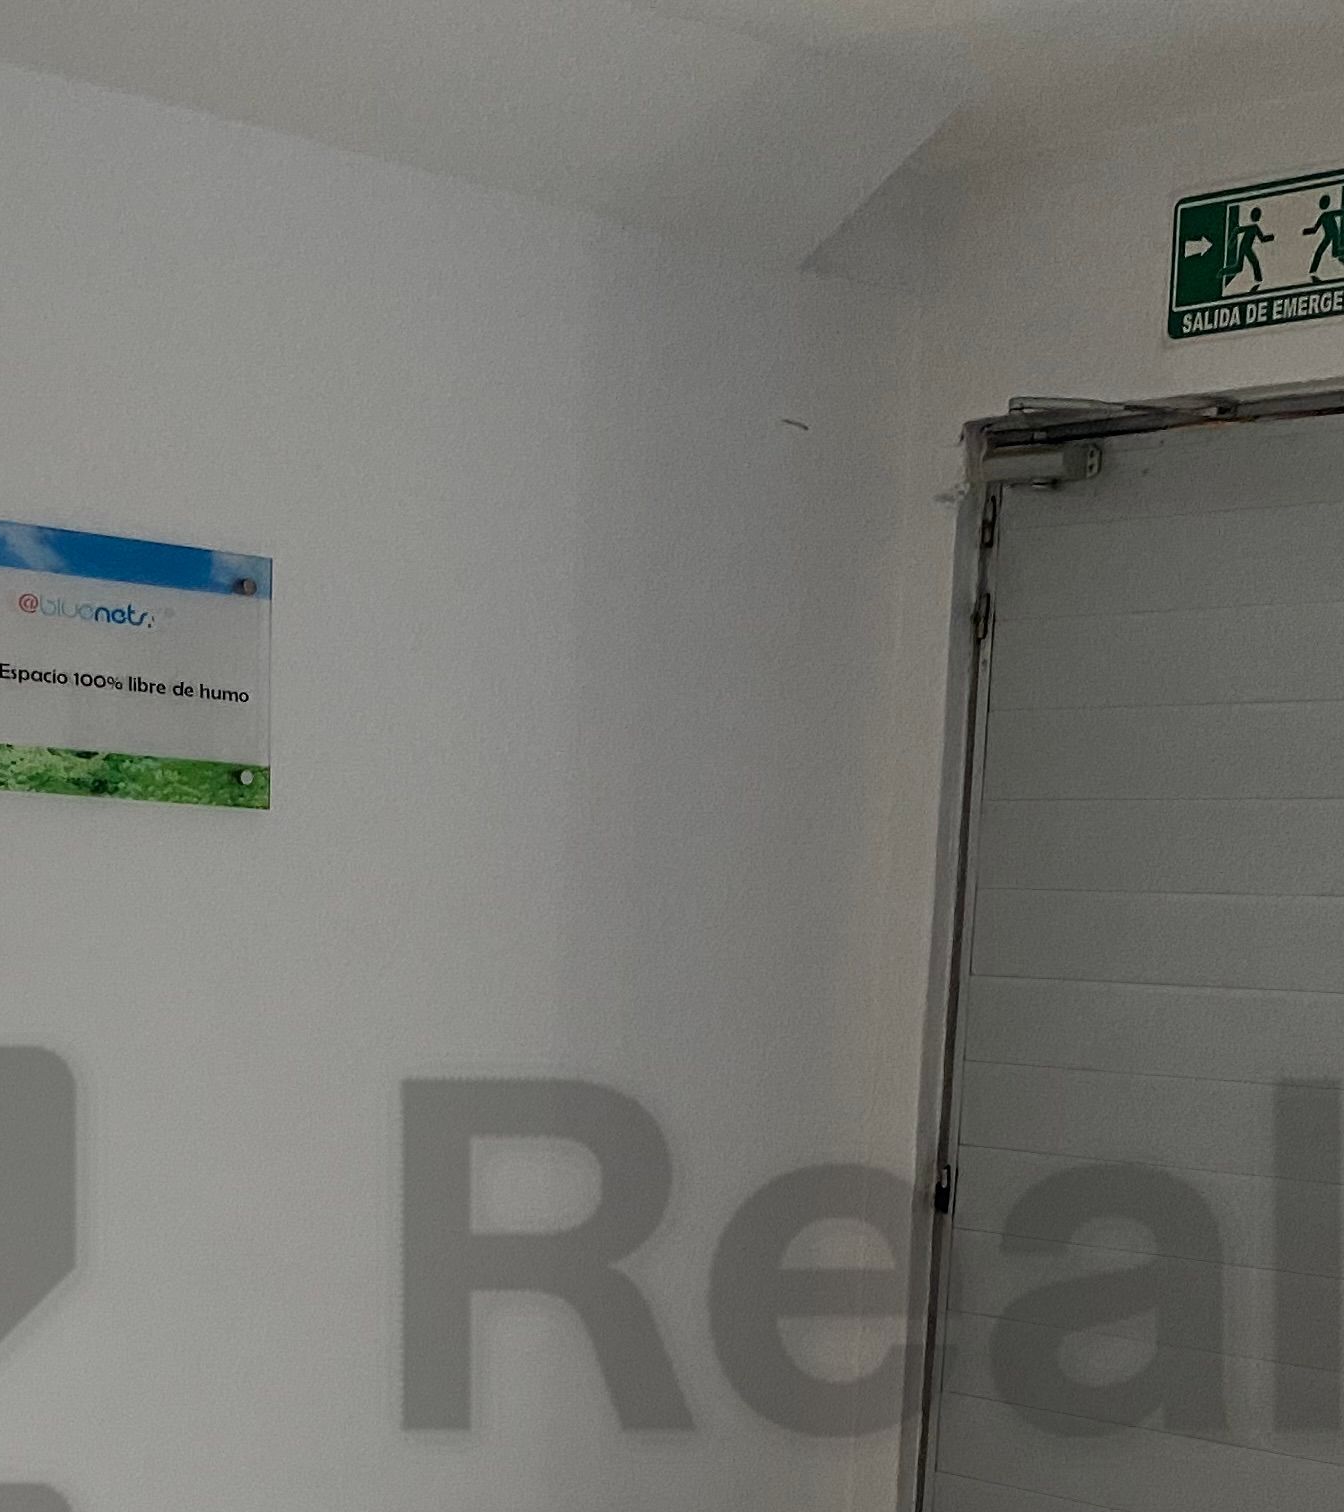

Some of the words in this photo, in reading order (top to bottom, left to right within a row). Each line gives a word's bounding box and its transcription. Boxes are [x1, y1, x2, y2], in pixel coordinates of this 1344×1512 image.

[1182, 307, 1241, 333] SALIDA
[1246, 302, 1267, 324] DE
[73, 672, 124, 691] 100%
[128, 676, 166, 696] libre
[172, 680, 194, 698] de
[198, 683, 250, 704] humo
